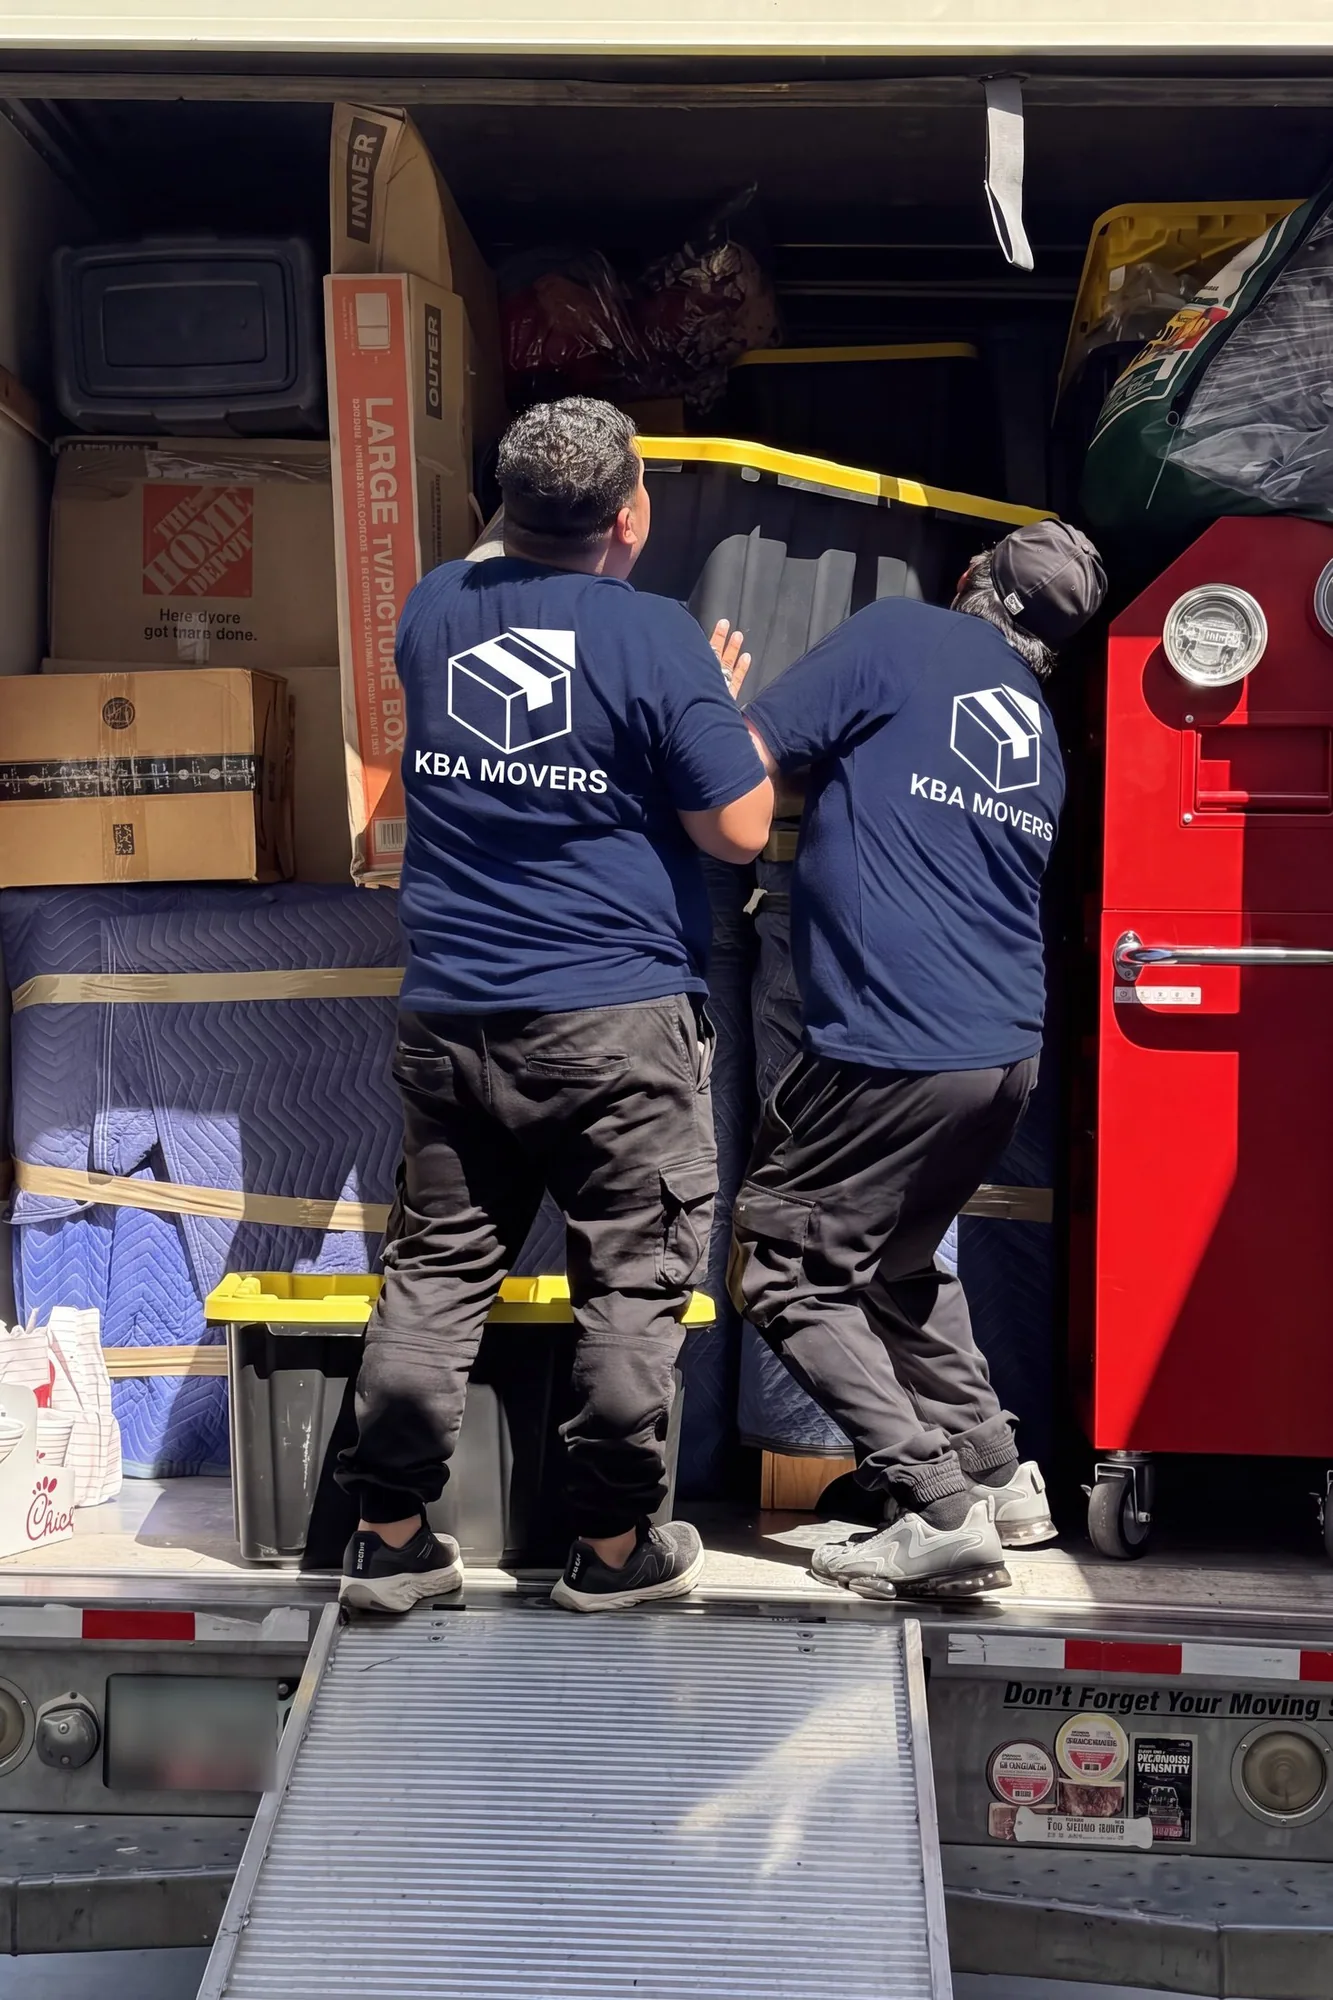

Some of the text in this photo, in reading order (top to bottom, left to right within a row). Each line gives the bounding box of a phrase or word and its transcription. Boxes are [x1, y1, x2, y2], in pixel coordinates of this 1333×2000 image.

[351, 132, 378, 230] INNER
[427, 314, 440, 408] OUTER
[143, 483, 253, 596] HOME
[153, 496, 203, 543] THE
[186, 526, 253, 596] DEPOT
[365, 397, 404, 755] LARGE TV/PICTURE BOX
[144, 626, 168, 640] got
[216, 628, 258, 641] done.
[415, 750, 608, 794] KBA MOVERS
[910, 773, 1053, 842] KBA MOVERS
[1004, 1681, 1071, 1707] Don't
[1078, 1687, 1160, 1715] Forget
[1167, 1691, 1222, 1713] Your
[1229, 1693, 1321, 1721] Moving
